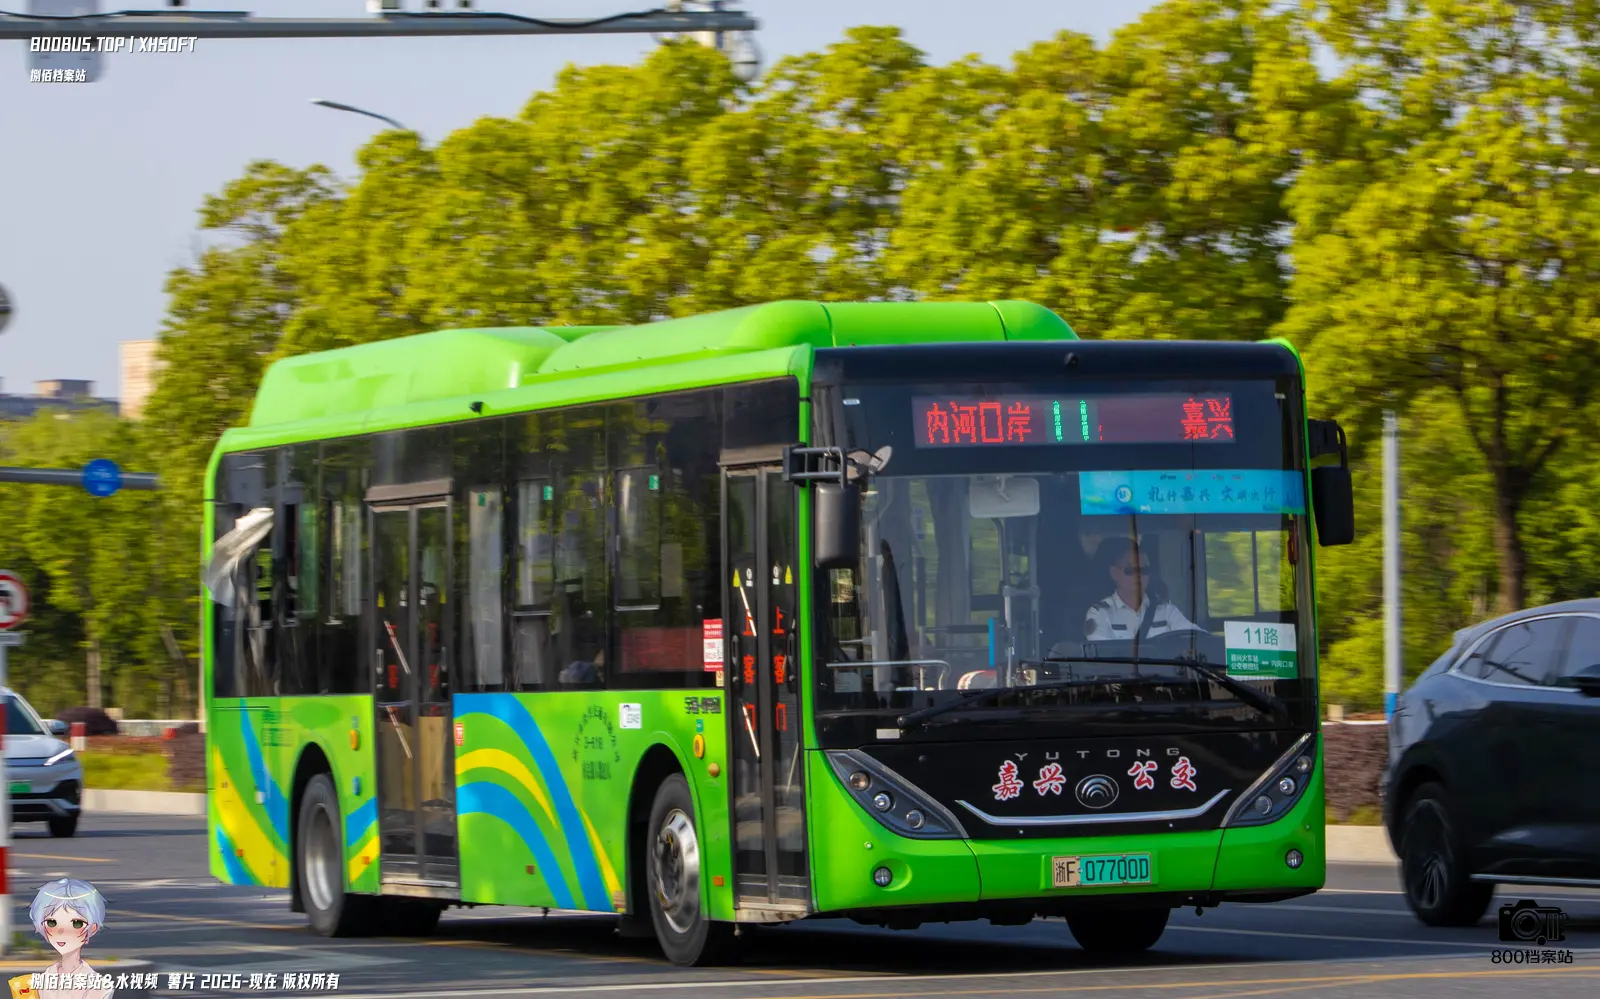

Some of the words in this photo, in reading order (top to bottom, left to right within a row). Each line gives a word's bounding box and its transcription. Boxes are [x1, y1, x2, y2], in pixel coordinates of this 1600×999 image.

[926, 401, 1032, 443] 内河口岸
[1053, 400, 1090, 441] 11
[1181, 397, 1234, 439] 嘉兴
[1244, 627, 1278, 646] 11路
[1015, 747, 1180, 761] YUTONG
[992, 760, 1067, 801] 嘉兴
[1127, 756, 1197, 793] 公交
